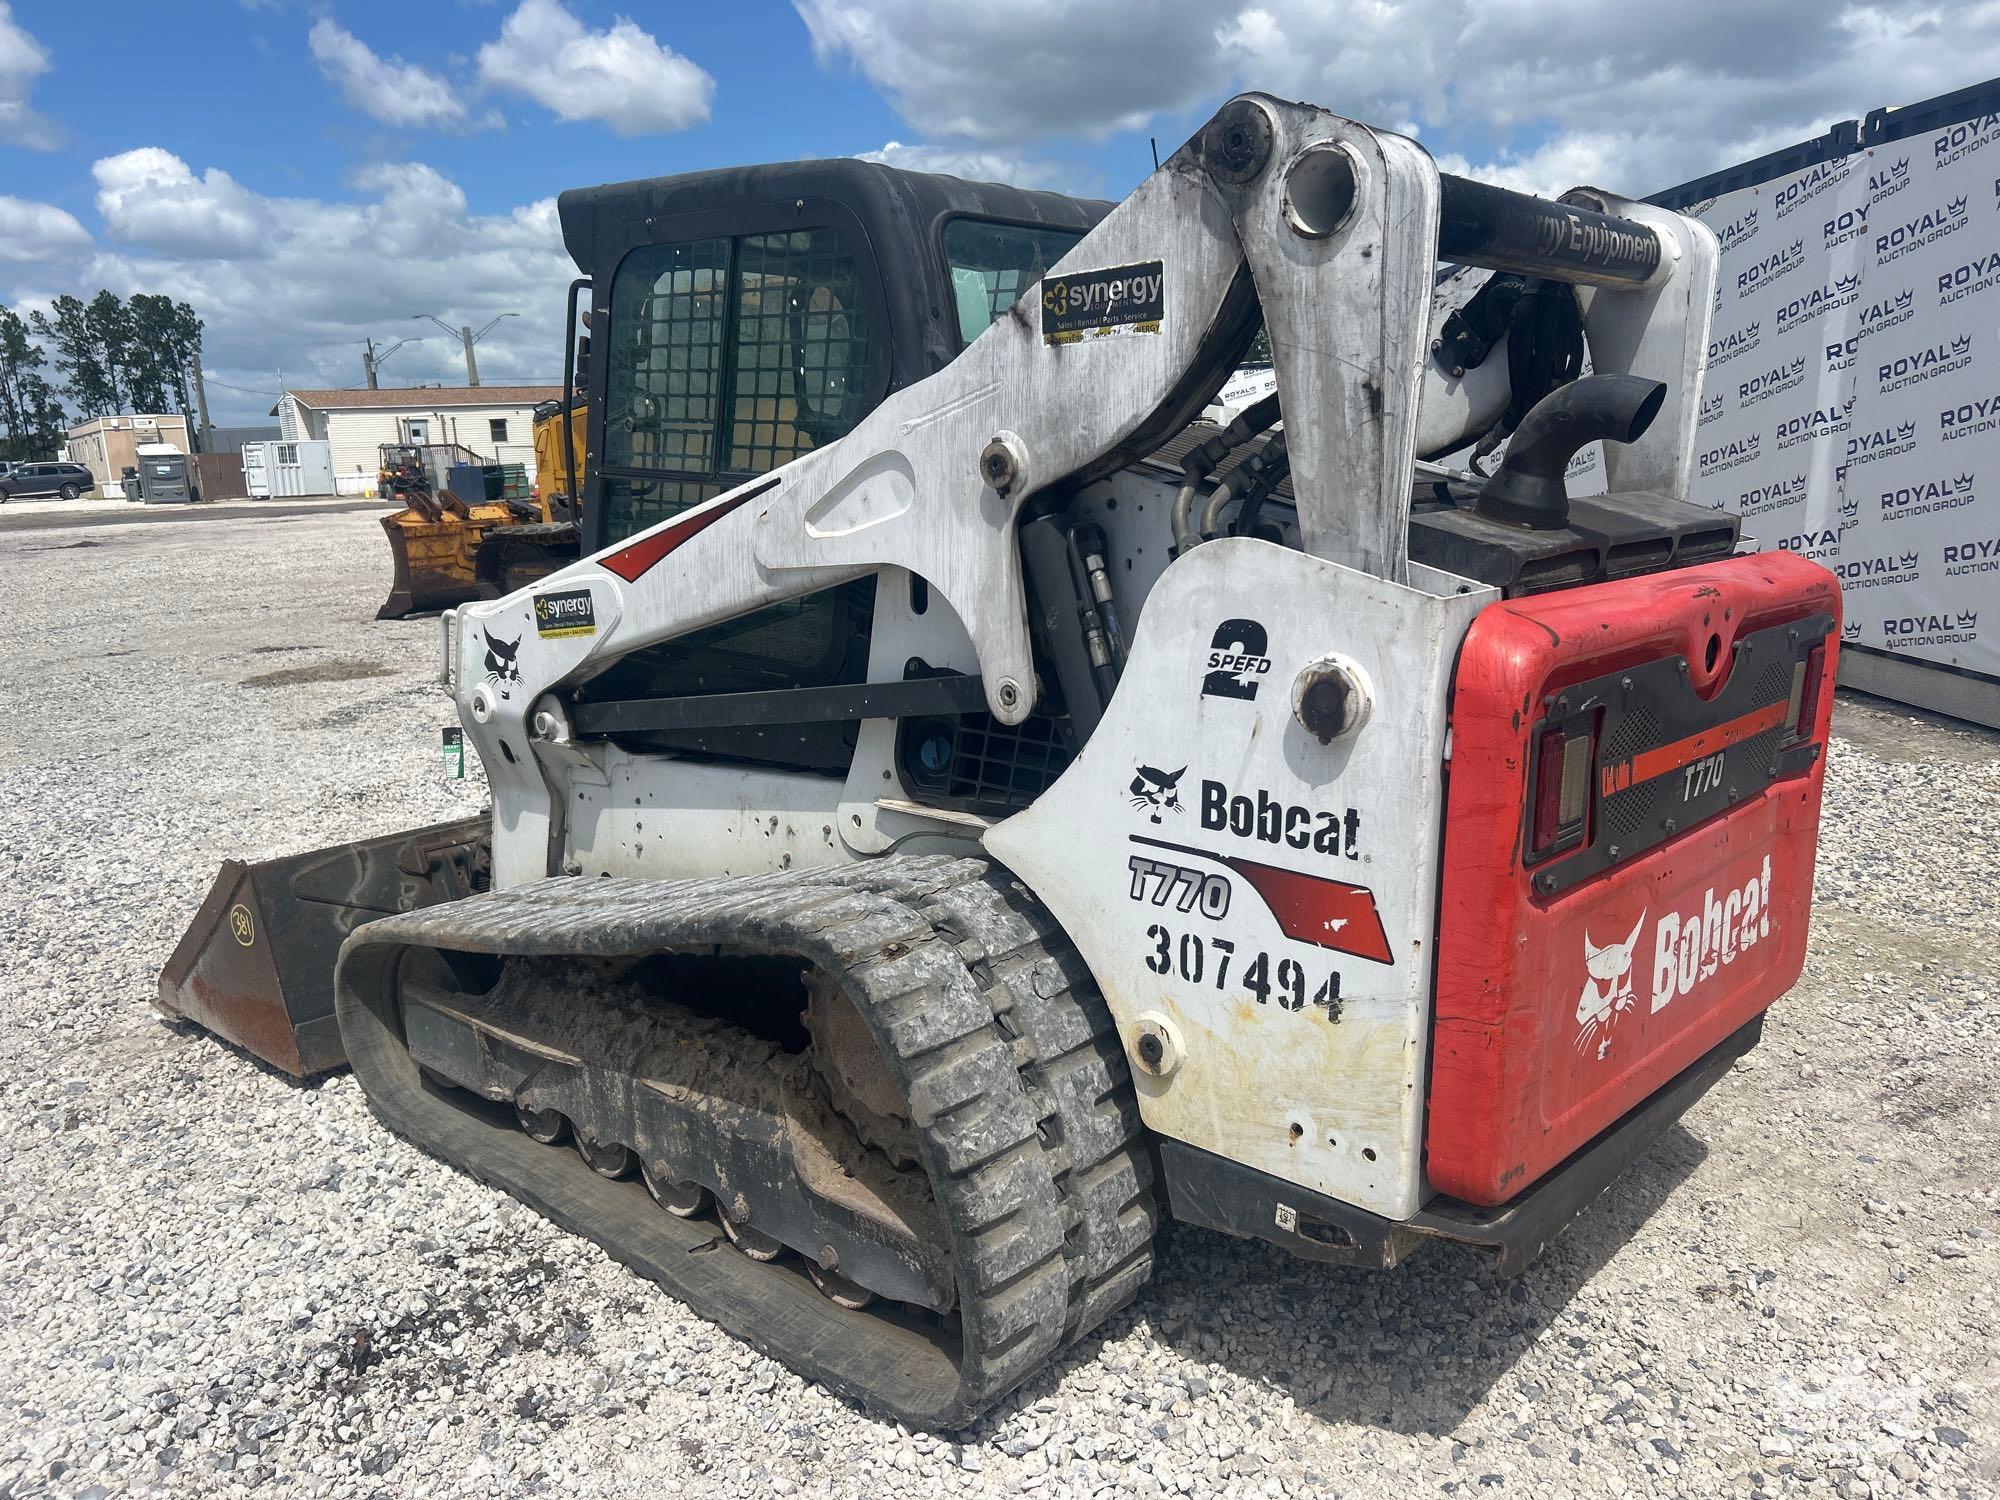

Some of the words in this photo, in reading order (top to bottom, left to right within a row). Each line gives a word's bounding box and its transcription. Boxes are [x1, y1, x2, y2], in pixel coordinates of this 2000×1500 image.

[1935, 134, 1989, 171] AUCTION
[1775, 164, 1831, 209] ROYAL
[1776, 190, 1814, 220] AUCTION
[1815, 168, 1850, 195] GROUP
[1872, 177, 1910, 204] GROUP
[1694, 197, 1717, 218] GROUP
[1566, 212, 1658, 265] Equipment
[1731, 226, 1759, 249] GROUP
[1876, 209, 1947, 254] ROYAL
[1877, 234, 1926, 267] AUCTION
[1927, 216, 1969, 244] GROUP
[1737, 250, 1790, 289] ROYAL
[1739, 273, 1774, 300] AUCTION
[1774, 256, 1805, 280] GROUP
[1070, 273, 1162, 312] synergy
[1090, 298, 1132, 311] EQUIMENT
[1776, 285, 1835, 324] ROYAL
[1940, 276, 1993, 307] AUCTION
[1057, 321, 1073, 331] Sales
[1077, 317, 1099, 328] Rental
[1102, 314, 1120, 324] Parts
[1123, 312, 1148, 322] Service
[1777, 308, 1815, 336] AUCTION
[1816, 293, 1859, 316] GROUP
[1876, 309, 1914, 332] GROUP
[1733, 338, 1760, 358] GROUP
[1879, 344, 1950, 382] ROYAL
[1880, 370, 1928, 395] AUCTION
[1930, 356, 1972, 378] GROUP
[1225, 388, 1250, 399] ROYAL
[1740, 365, 1790, 398] ROYAL
[1740, 388, 1774, 409] AUCTION
[1775, 375, 1805, 394] GROUP
[1698, 410, 1724, 427] GROUP
[1776, 406, 1843, 439] ROYAL
[1941, 419, 1996, 442] AUCTION
[1777, 429, 1818, 450] AUCTION
[1878, 441, 1916, 460] GROUP
[1699, 440, 1747, 468] ROYAL
[1700, 460, 1733, 478] AUCTION
[1733, 450, 1760, 467] GROUP
[1740, 481, 1791, 509] ROYAL
[1740, 503, 1776, 519] AUCTION
[1776, 493, 1807, 509] GROUP
[1881, 480, 1953, 509] ROYAL
[1882, 504, 1931, 522] AUCTION
[1932, 495, 1975, 512] GROUP
[1881, 572, 1919, 586] GROUP
[1945, 561, 1999, 576] AUCTION
[547, 596, 591, 618] synergy
[1883, 615, 1954, 635] ROYAL
[1886, 635, 1935, 650] AUCTION
[1937, 632, 1977, 645] GROUP
[1201, 618, 1268, 701] 2
[1207, 651, 1272, 676] SPEED
[1683, 752, 1725, 802] T770
[1200, 778, 1360, 861] Bobcat
[1129, 855, 1232, 921] T770
[233, 911, 252, 937] 381
[1650, 853, 1771, 1015] Bobcat
[1145, 924, 1343, 1025] 307494
